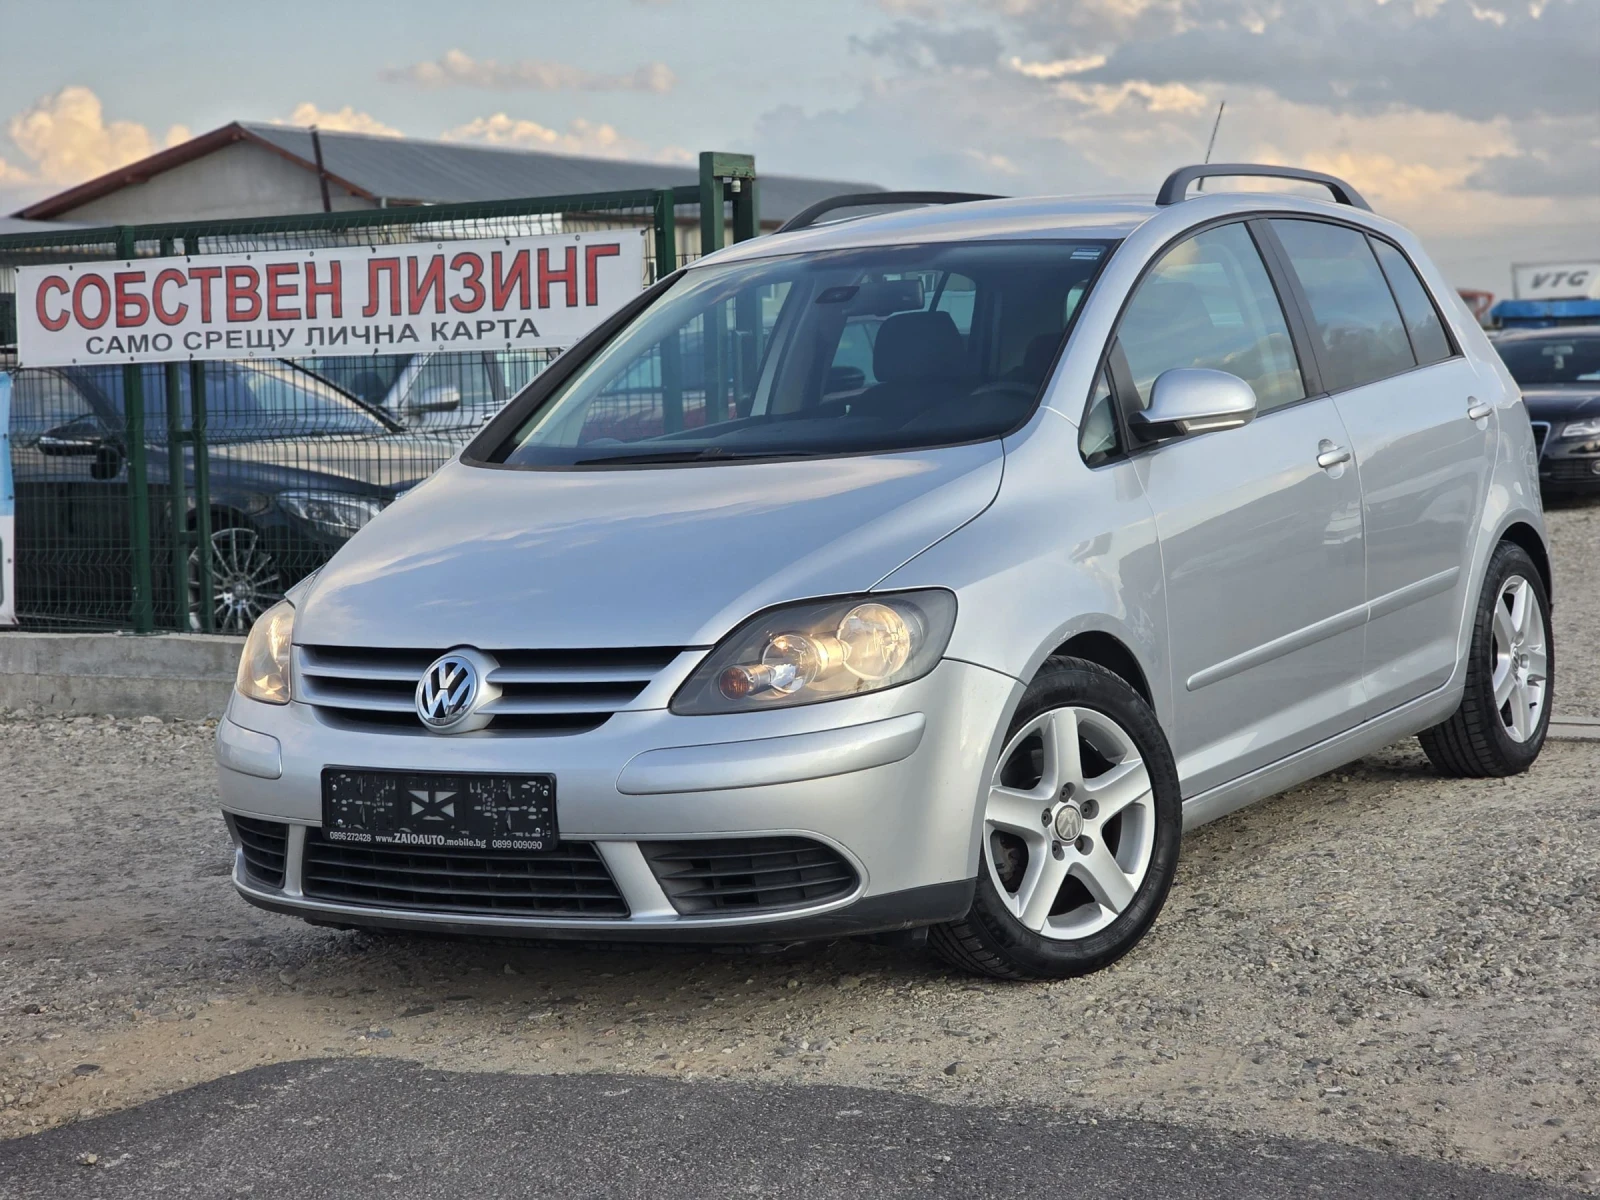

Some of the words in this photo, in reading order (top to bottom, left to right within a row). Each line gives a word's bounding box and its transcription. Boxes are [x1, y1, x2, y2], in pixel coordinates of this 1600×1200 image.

[35, 260, 343, 332] СОБСТВЕН
[362, 243, 621, 318] ЛИЗИНГ
[85, 331, 173, 356] САМО
[182, 327, 295, 352] СРЕЩУ
[304, 323, 419, 347] ЛИЧНА
[430, 317, 541, 342] КАРТА
[492, 839, 512, 849] 0899
[513, 840, 543, 850] 009090
